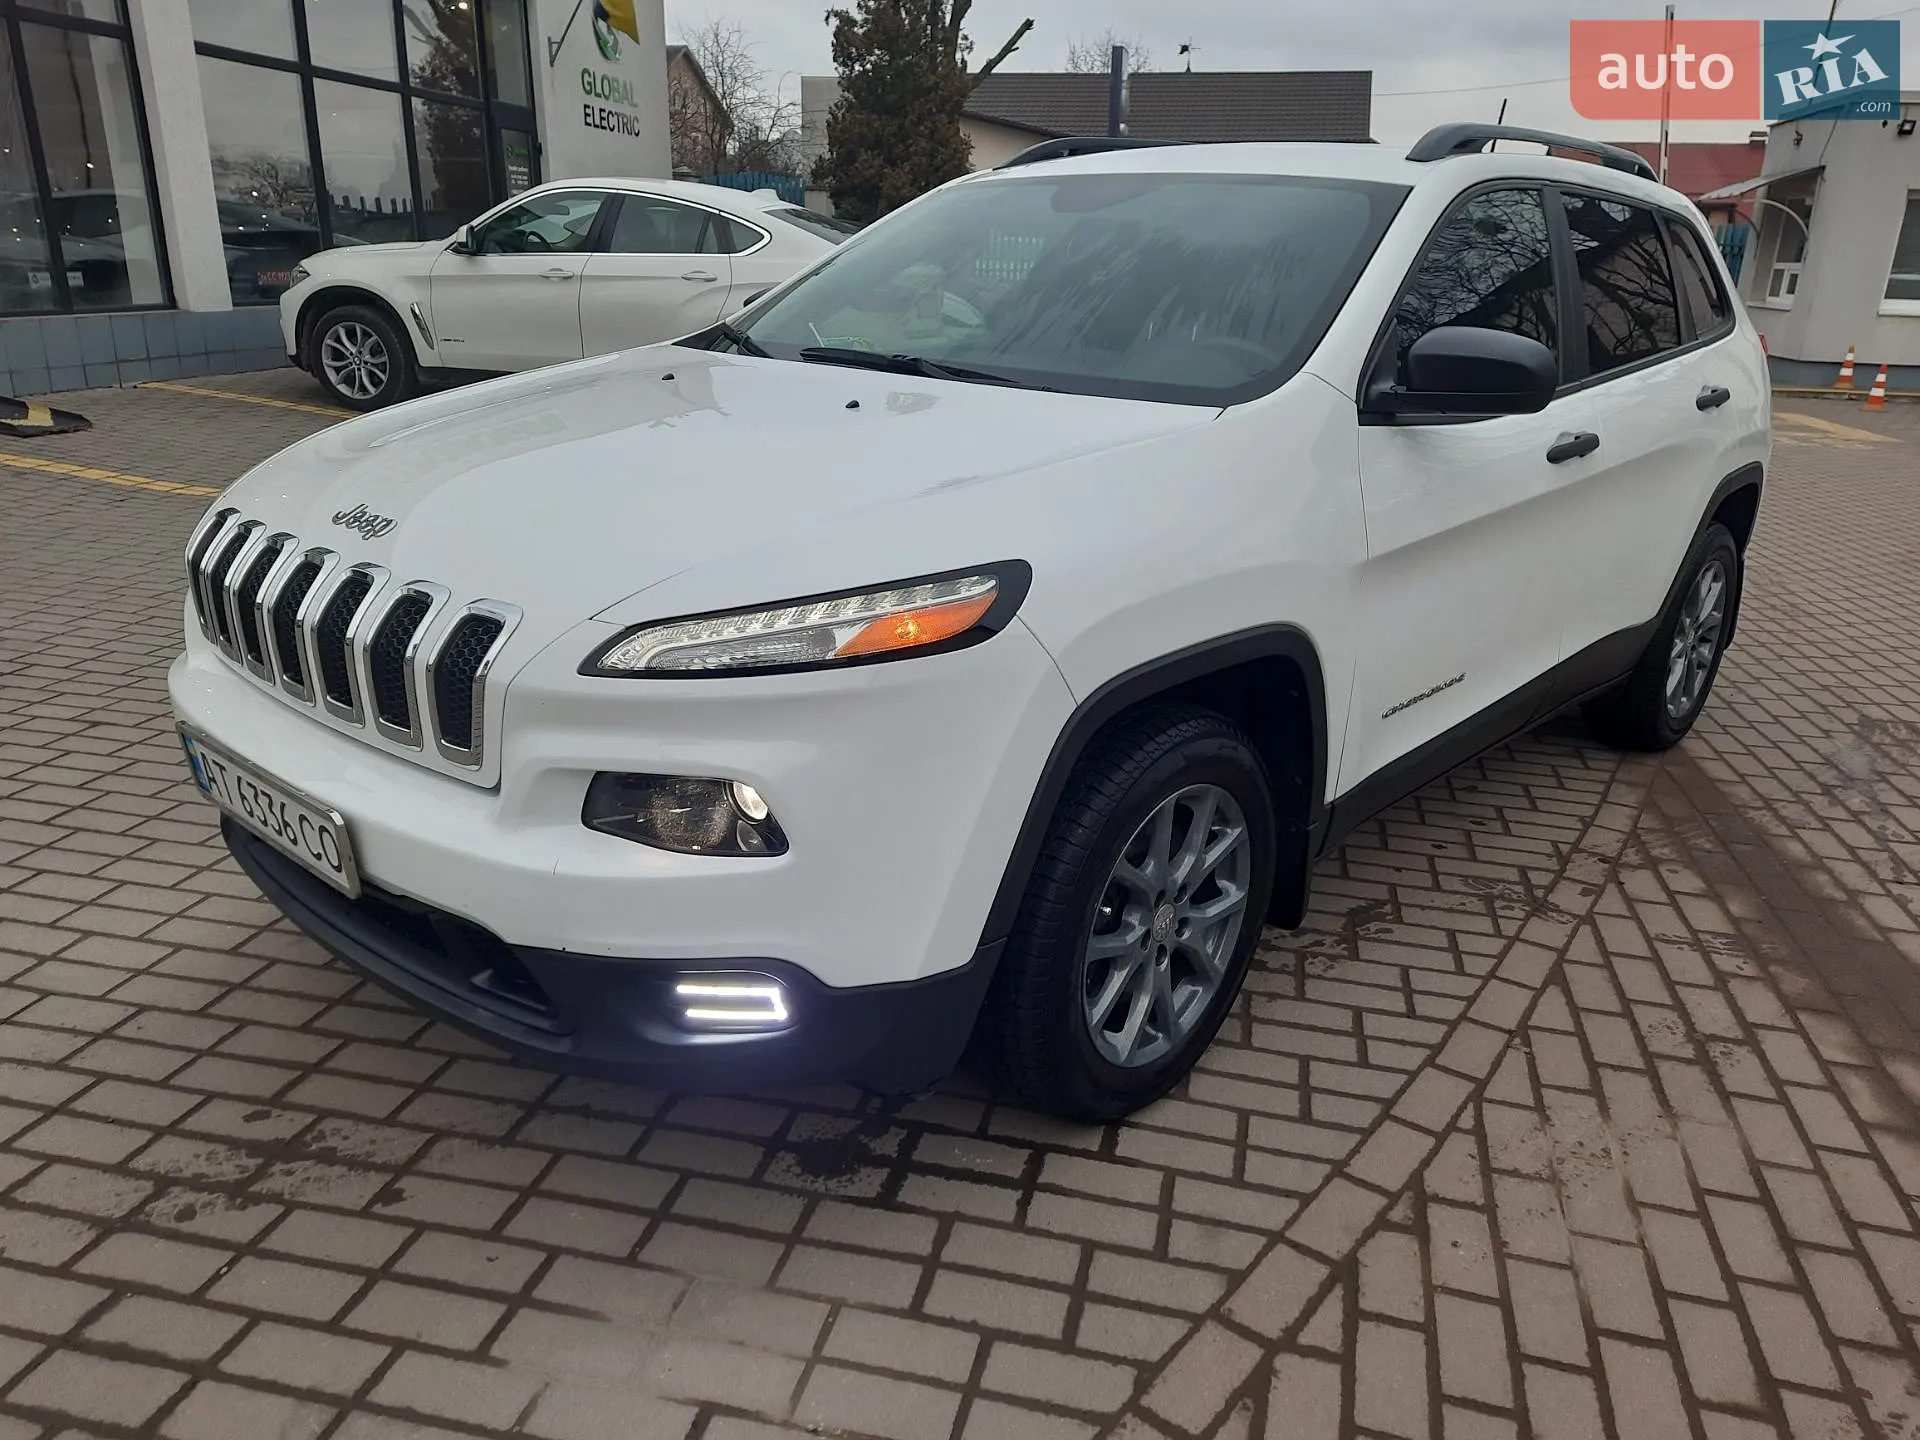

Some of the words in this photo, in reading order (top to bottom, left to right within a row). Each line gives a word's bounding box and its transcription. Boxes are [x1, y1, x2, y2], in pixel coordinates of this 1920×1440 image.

[581, 67, 638, 108] GLOBAL
[583, 104, 640, 137] ELECTRIC
[331, 503, 398, 541] Jeep
[200, 751, 233, 804] AT
[236, 774, 298, 846] 6336
[298, 812, 342, 873] CO
